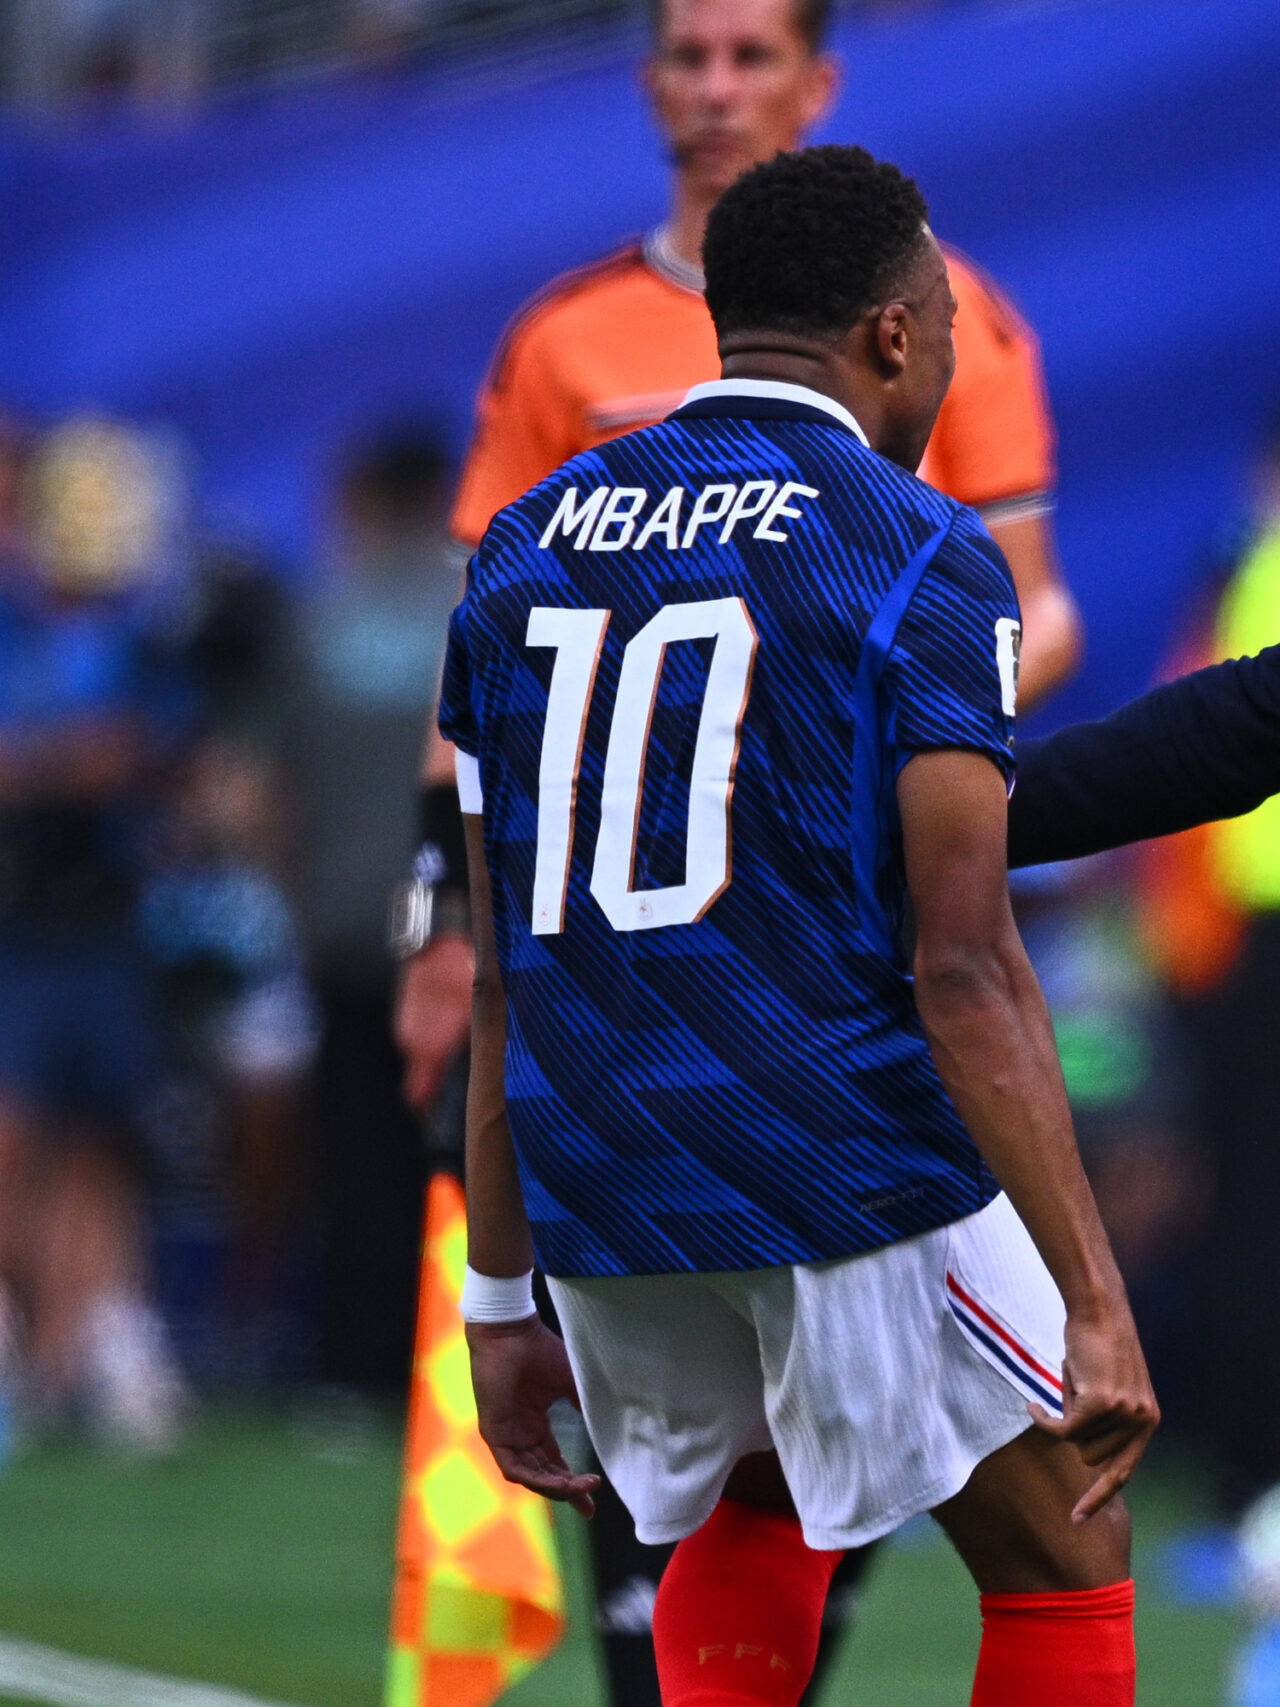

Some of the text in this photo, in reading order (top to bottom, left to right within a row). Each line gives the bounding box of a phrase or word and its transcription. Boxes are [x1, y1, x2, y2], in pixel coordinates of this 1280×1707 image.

[538, 480, 819, 551] MBAPPE
[525, 596, 759, 935] 10
[698, 1643, 791, 1672] FFF
